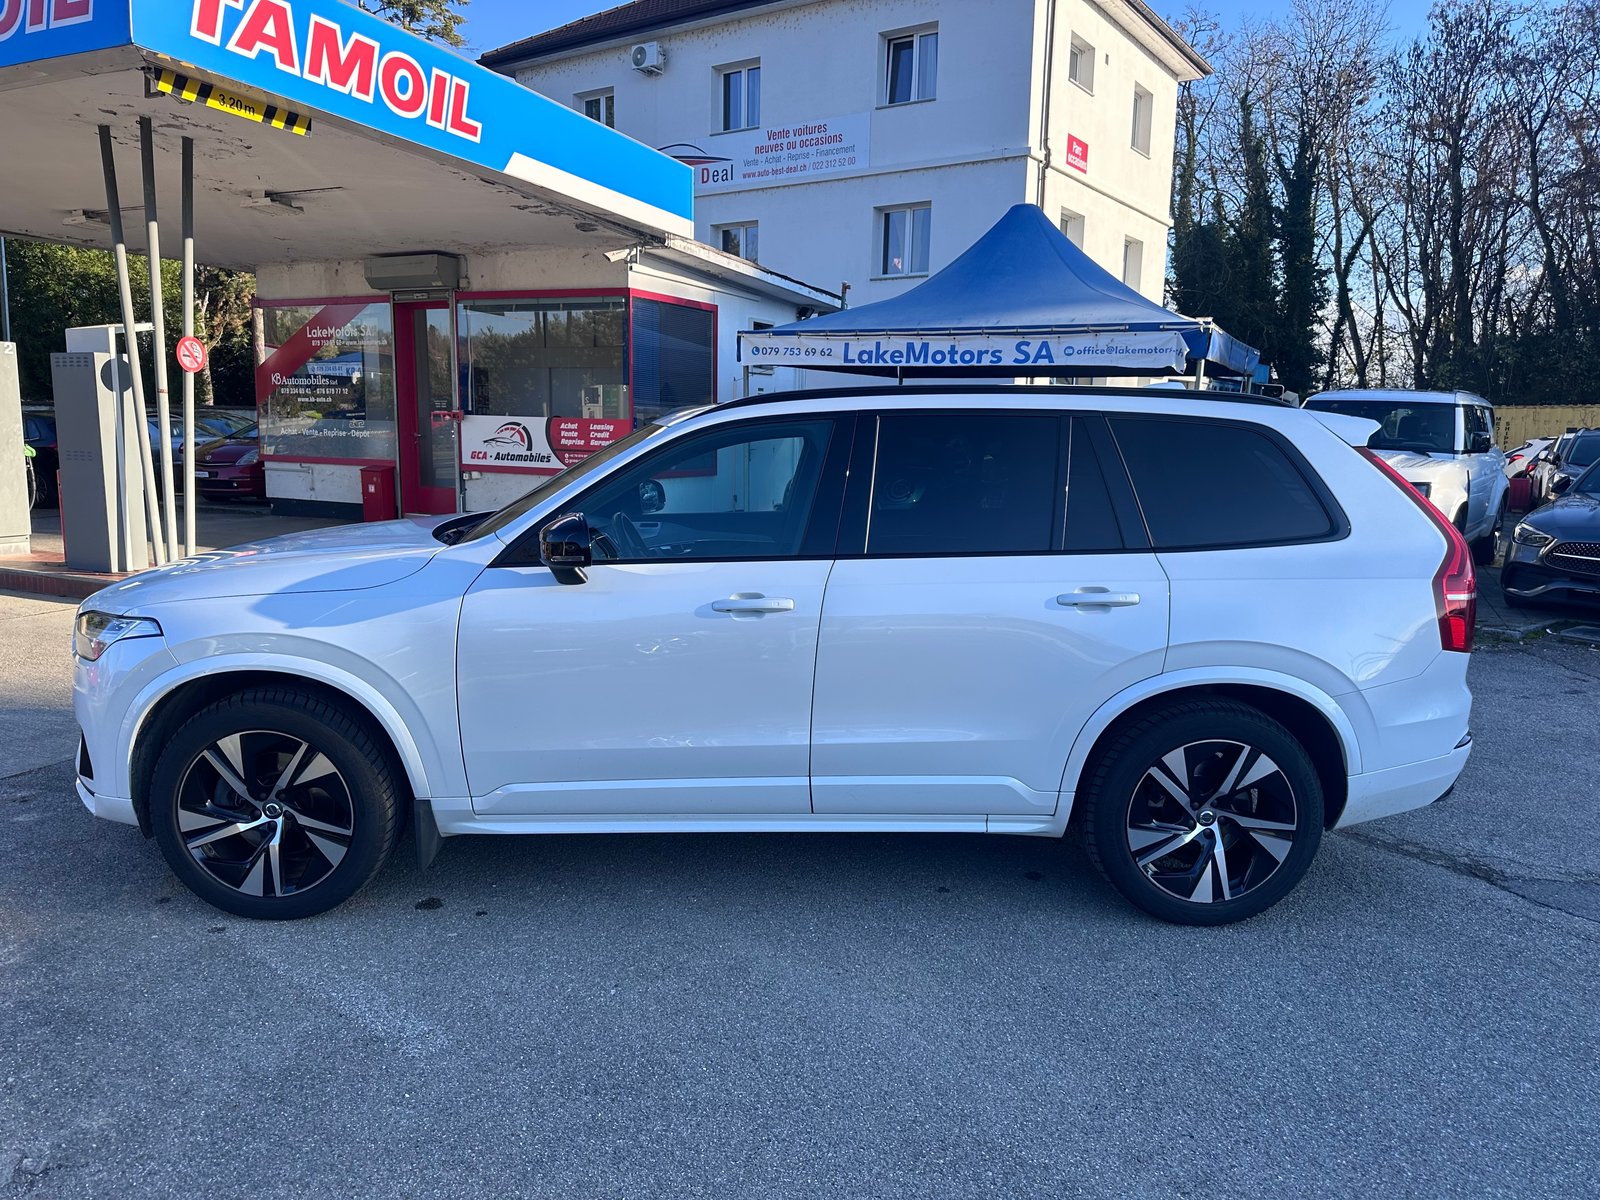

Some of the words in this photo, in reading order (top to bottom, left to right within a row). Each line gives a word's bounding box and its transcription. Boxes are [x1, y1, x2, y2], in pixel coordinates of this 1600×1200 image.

[190, 0, 482, 143] TAMOIL
[218, 93, 243, 111] 3.20
[244, 104, 256, 116] m
[766, 128, 790, 141] Vente
[792, 123, 828, 137] voitures
[754, 142, 784, 155] neuves
[786, 141, 797, 150] ou
[799, 133, 843, 148] occasions
[743, 158, 759, 167] Vente
[764, 155, 782, 165] Achat
[787, 150, 810, 162] Reprise
[815, 144, 856, 157] Financement
[701, 164, 734, 184] Deal
[742, 163, 807, 179] www.auto-best-deal.ch
[812, 160, 824, 171] 022
[825, 158, 837, 168] 312
[838, 158, 847, 167] 52
[847, 156, 856, 165] 00
[306, 325, 358, 338] LakeMotors
[4, 343, 14, 355] 2
[761, 346, 780, 356] 079
[782, 346, 801, 356] 753
[804, 347, 817, 357] 69
[819, 347, 833, 357] 62
[843, 341, 1003, 365] LakeMotors
[1013, 340, 1055, 364] SA
[281, 375, 330, 385] Automobiles
[323, 428, 346, 438] Reprise
[560, 422, 578, 430] Achat
[590, 423, 614, 432] Leasing
[560, 438, 584, 446] Reprise
[470, 450, 488, 460] GCA
[494, 451, 552, 463] Automobiles
